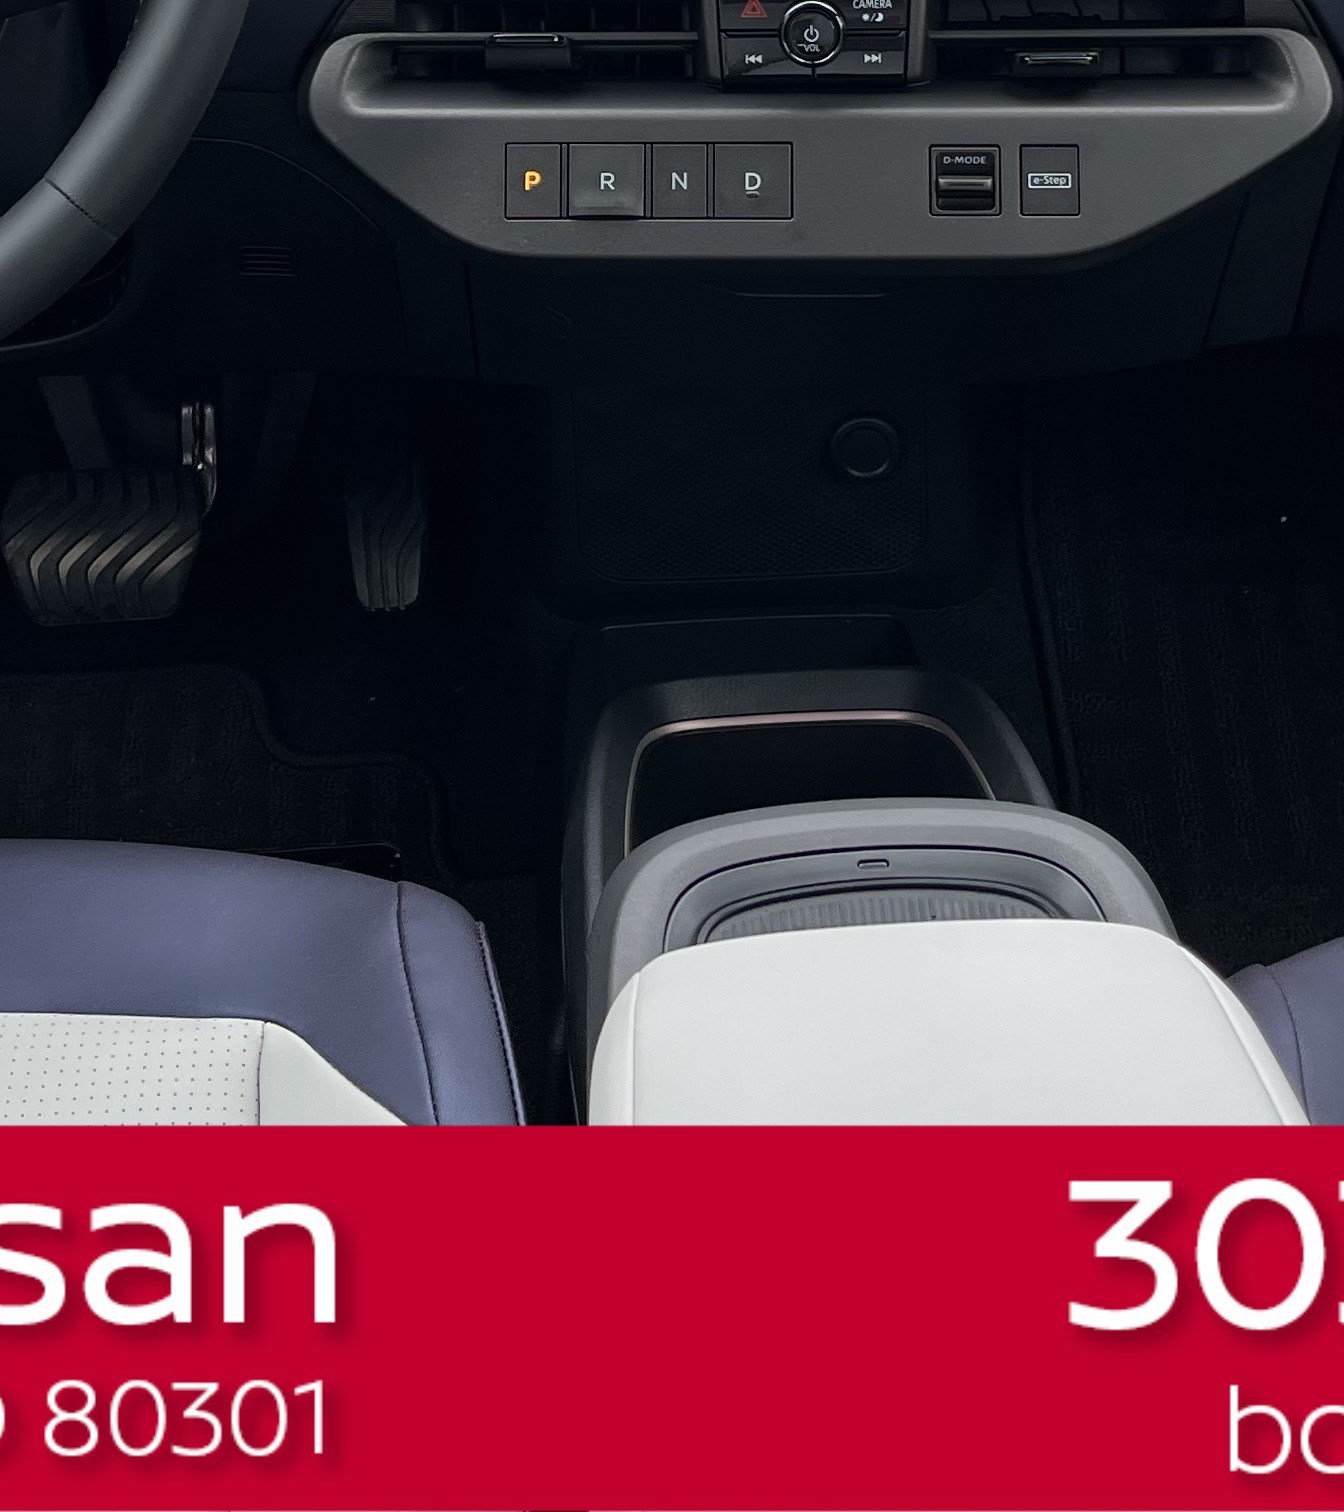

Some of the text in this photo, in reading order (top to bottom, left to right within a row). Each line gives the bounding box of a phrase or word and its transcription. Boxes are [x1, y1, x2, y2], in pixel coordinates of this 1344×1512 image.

[852, 0, 892, 9] CAMERA
[804, 44, 820, 52] VOL
[943, 156, 987, 164] D-MODE
[525, 171, 540, 190] P
[601, 173, 615, 190] R
[672, 172, 687, 190] N
[745, 173, 761, 190] D
[1033, 175, 1067, 186] e-Step
